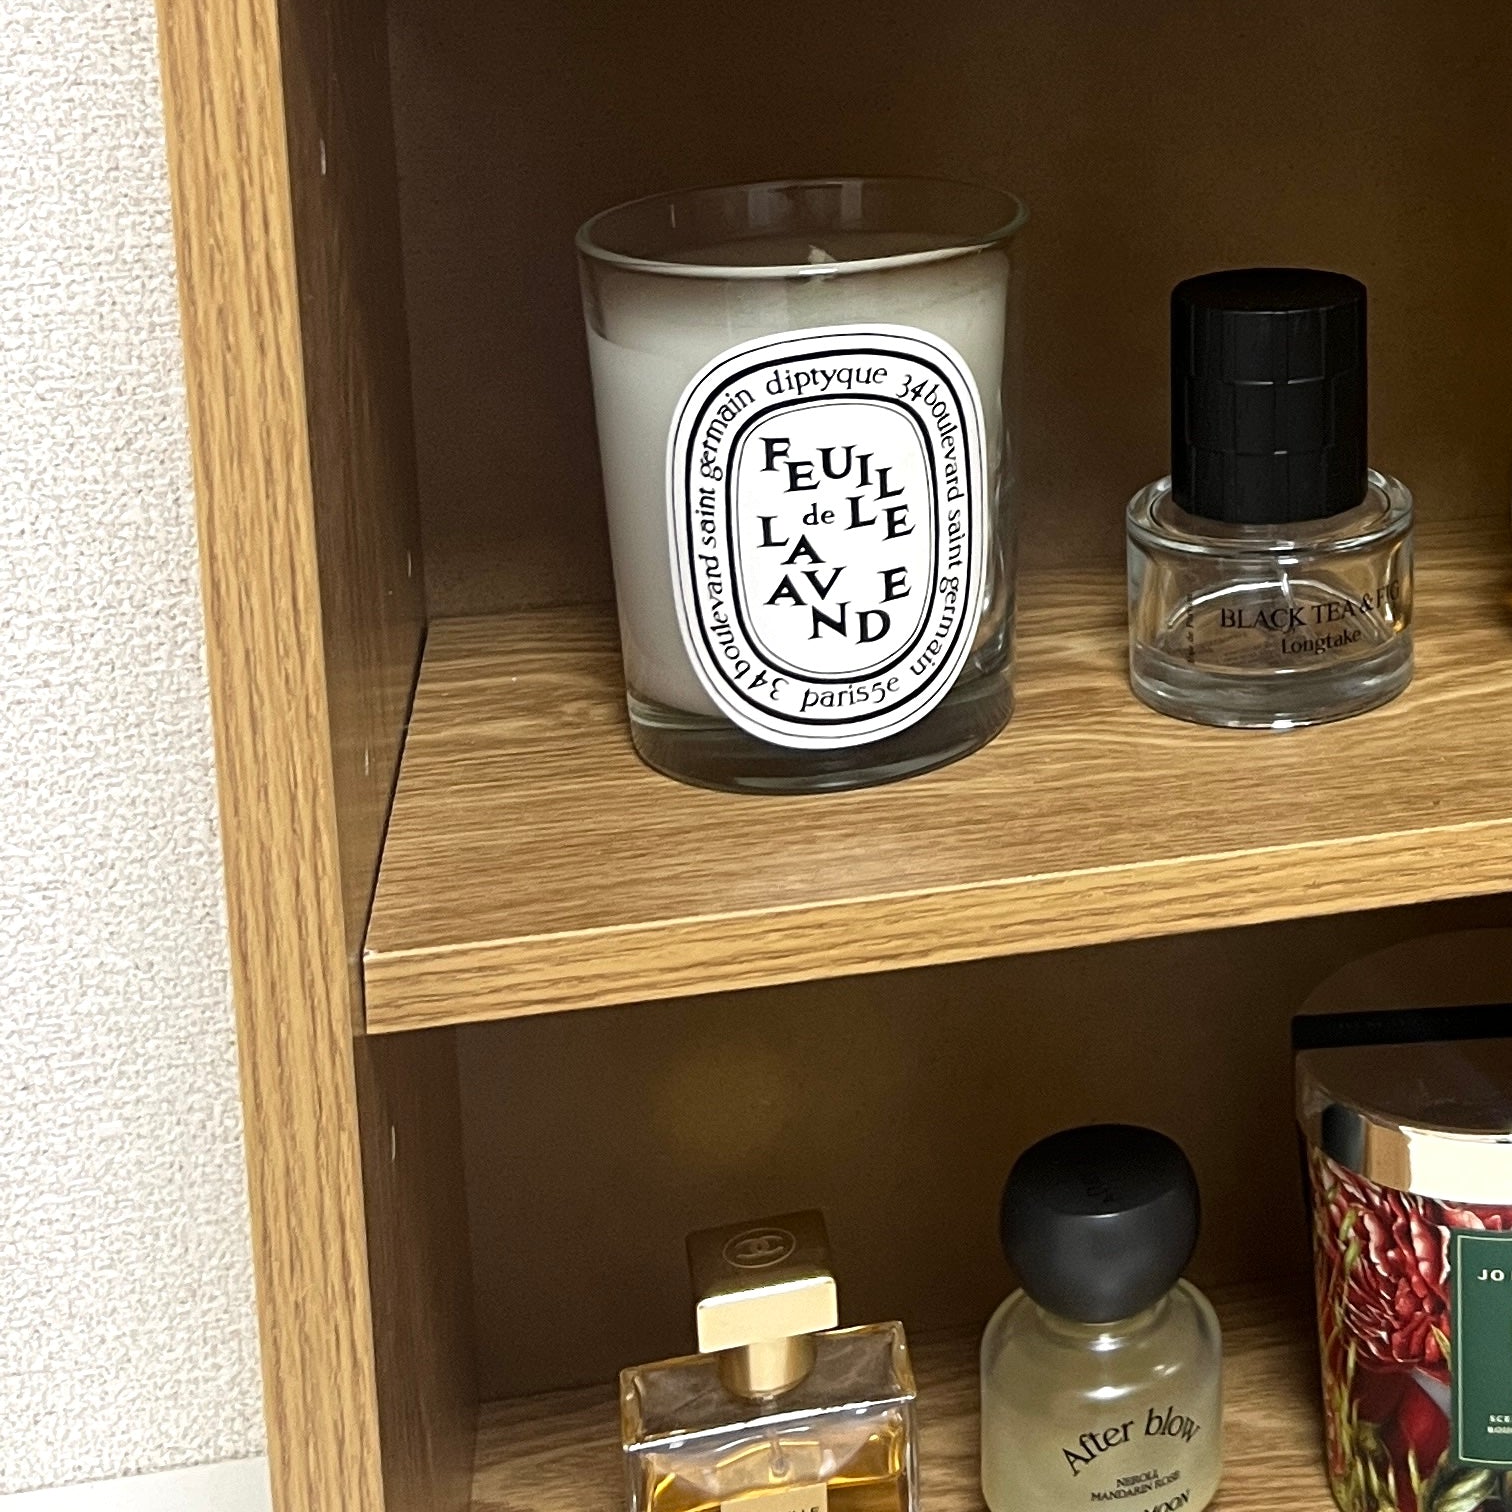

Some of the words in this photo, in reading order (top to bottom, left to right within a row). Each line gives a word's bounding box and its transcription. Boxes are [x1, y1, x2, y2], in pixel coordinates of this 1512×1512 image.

[766, 367, 888, 395] diptyque
[700, 389, 756, 482] germain
[695, 488, 717, 549] saint
[802, 502, 836, 526] de
[948, 509, 966, 570] saint
[1220, 606, 1307, 630] BLACK
[1311, 600, 1356, 625] TEA
[1359, 592, 1374, 614] &
[1376, 580, 1400, 609] FIG
[909, 576, 960, 676] germain
[1281, 628, 1362, 655] Longtake
[1477, 1269, 1505, 1282] JO
[1062, 1420, 1135, 1477] After
[1144, 1405, 1201, 1443] blow
[1090, 1483, 1154, 1502] MANDARIN
[1154, 1470, 1181, 1489] ROSE
[1116, 1469, 1159, 1488] NEROLI
